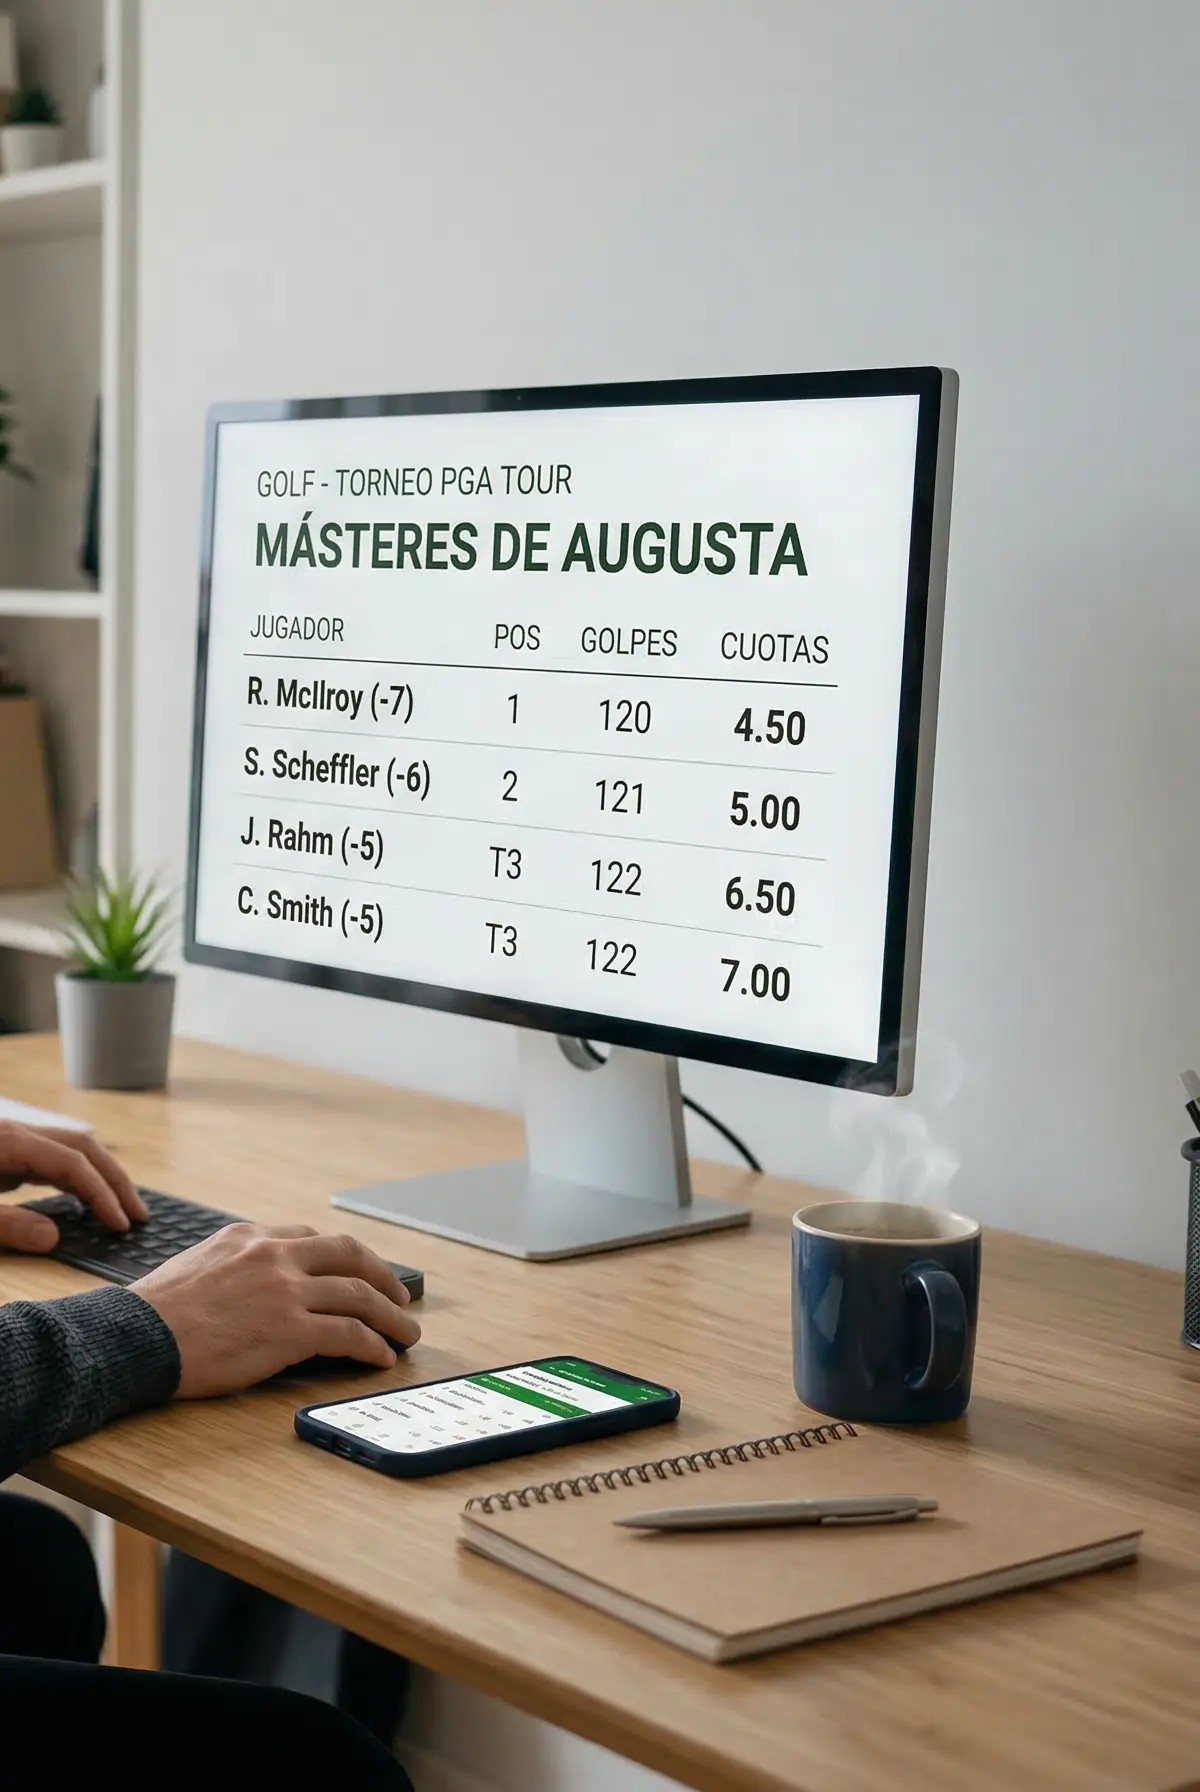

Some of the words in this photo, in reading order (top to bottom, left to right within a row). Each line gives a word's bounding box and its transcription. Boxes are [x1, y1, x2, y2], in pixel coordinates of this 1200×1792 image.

[257, 469, 316, 498] GOLF
[335, 466, 433, 497] TORNEO
[441, 465, 493, 496] PGA
[500, 464, 572, 495] TOUR
[255, 510, 479, 571] MÁSTERES
[491, 522, 551, 572] DE
[560, 521, 809, 577] AUGUSTA
[250, 614, 344, 642] JUGADOR
[494, 623, 541, 651] POS
[581, 626, 678, 657] GOLPES
[721, 631, 830, 665] CUOTAS
[247, 675, 269, 706] R.
[276, 678, 364, 720] McIlroy
[370, 681, 414, 725] (-7)
[507, 693, 518, 724] 1
[599, 699, 652, 734] 120
[733, 707, 806, 746] 4.50
[243, 746, 265, 777] S.
[271, 748, 380, 788] Scheffler
[386, 756, 431, 802] (-6)
[502, 769, 518, 802] 2
[595, 779, 643, 815] 121
[729, 790, 801, 832] 5.00
[240, 816, 260, 847] J.
[268, 818, 334, 856] Rahm
[341, 825, 384, 870] (-5)
[489, 845, 522, 880] T3
[591, 859, 642, 897] 122
[725, 876, 796, 917] 6.50
[237, 885, 259, 916] C.
[266, 889, 333, 928] Smith
[341, 898, 384, 944] (-5)
[485, 922, 518, 957] T3
[586, 938, 637, 977] 122
[720, 957, 791, 1002] 7.00
